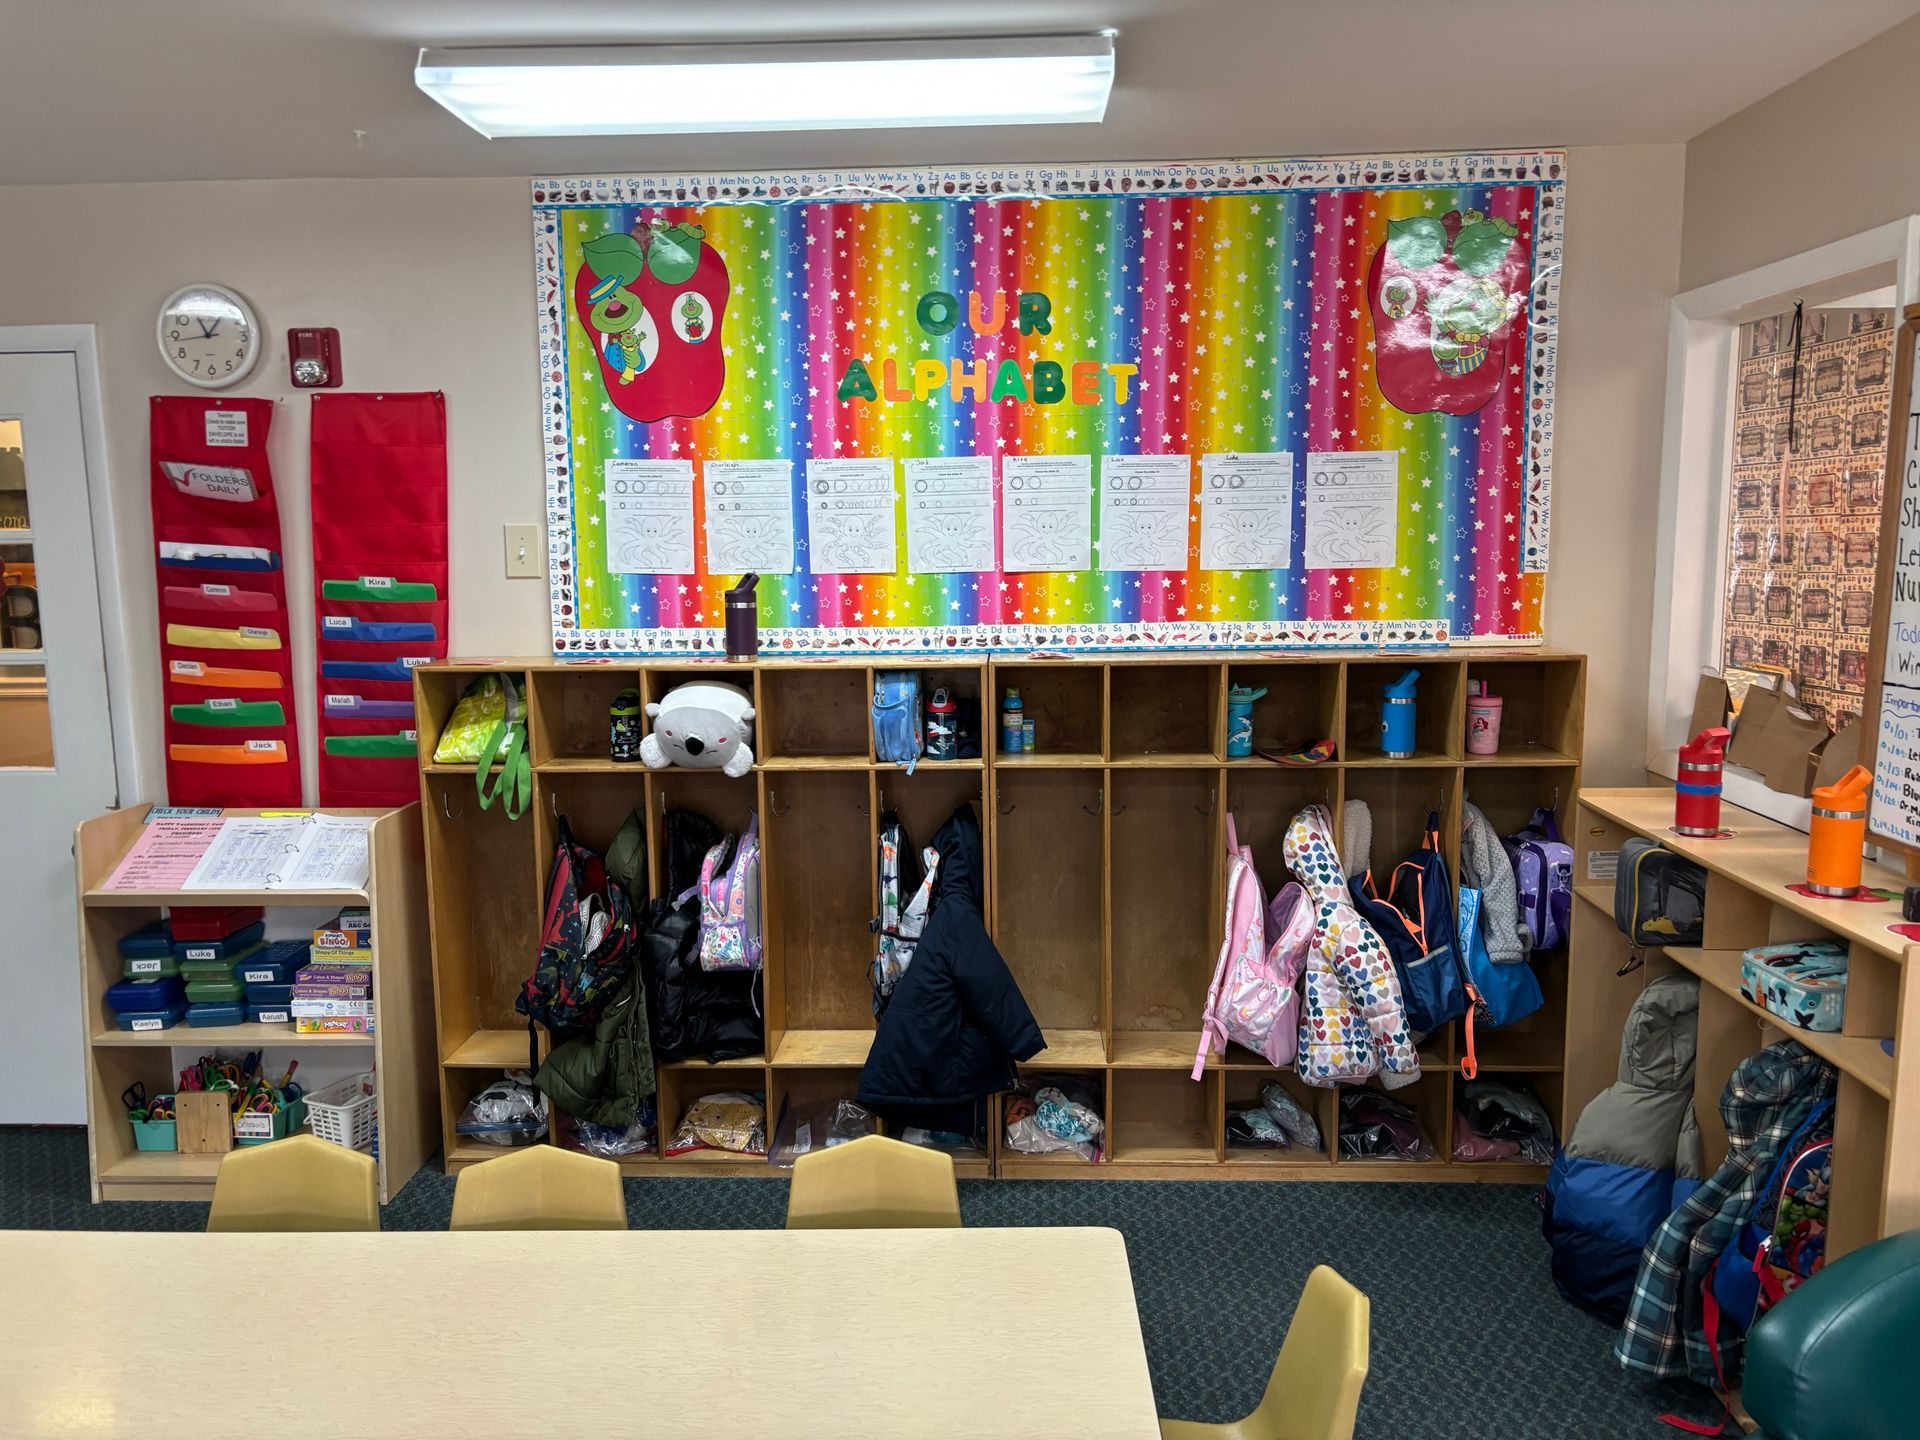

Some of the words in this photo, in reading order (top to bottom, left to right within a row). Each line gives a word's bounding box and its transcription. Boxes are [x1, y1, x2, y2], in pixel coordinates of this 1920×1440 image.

[916, 291, 1052, 336] OUR
[176, 314, 189, 326] 10
[170, 330, 180, 341] 9
[240, 331, 248, 342] 3
[179, 347, 186, 359] 8
[236, 349, 243, 358] 4
[193, 360, 200, 371] 7
[208, 364, 216, 375] 6
[225, 361, 232, 371] 5
[837, 358, 1138, 405] ALPHABET
[192, 472, 248, 487] FOLDERS
[208, 482, 240, 495] DAILY
[368, 578, 386, 586] Kira
[1895, 572, 1920, 602] Nu
[329, 618, 347, 626] Luca
[212, 700, 232, 708] Ethan
[320, 938, 348, 946] BINGO!
[190, 950, 211, 958] Luke
[249, 973, 268, 981] Kira
[262, 1013, 284, 1021] Aarush
[134, 1020, 160, 1029] Kaelyn
